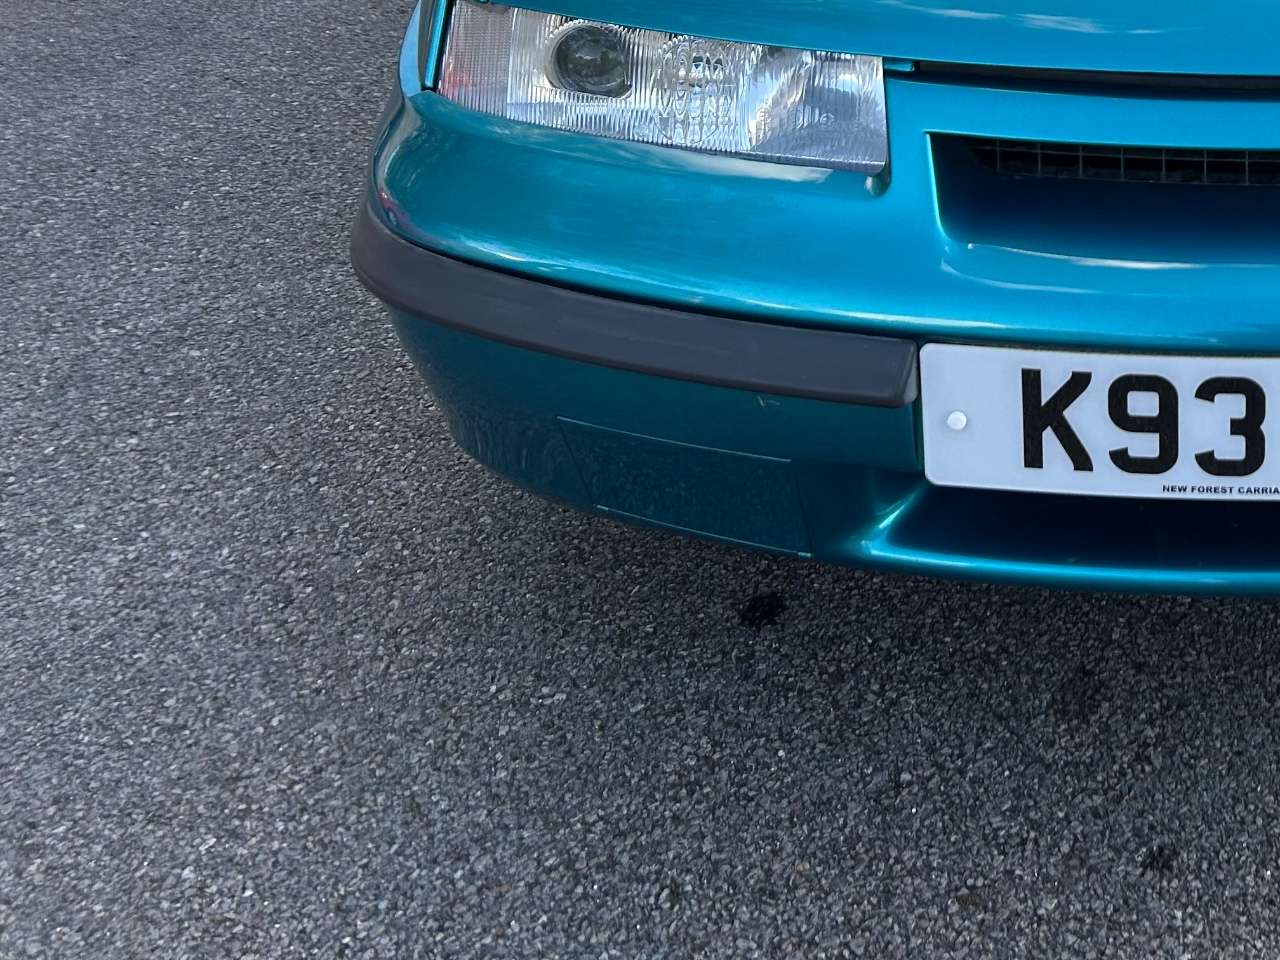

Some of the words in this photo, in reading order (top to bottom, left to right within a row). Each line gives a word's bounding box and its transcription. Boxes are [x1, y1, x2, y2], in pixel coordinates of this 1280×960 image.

[1021, 367, 1266, 477] K93
[1162, 484, 1187, 493] NEW
[1191, 485, 1234, 494] FOREST
